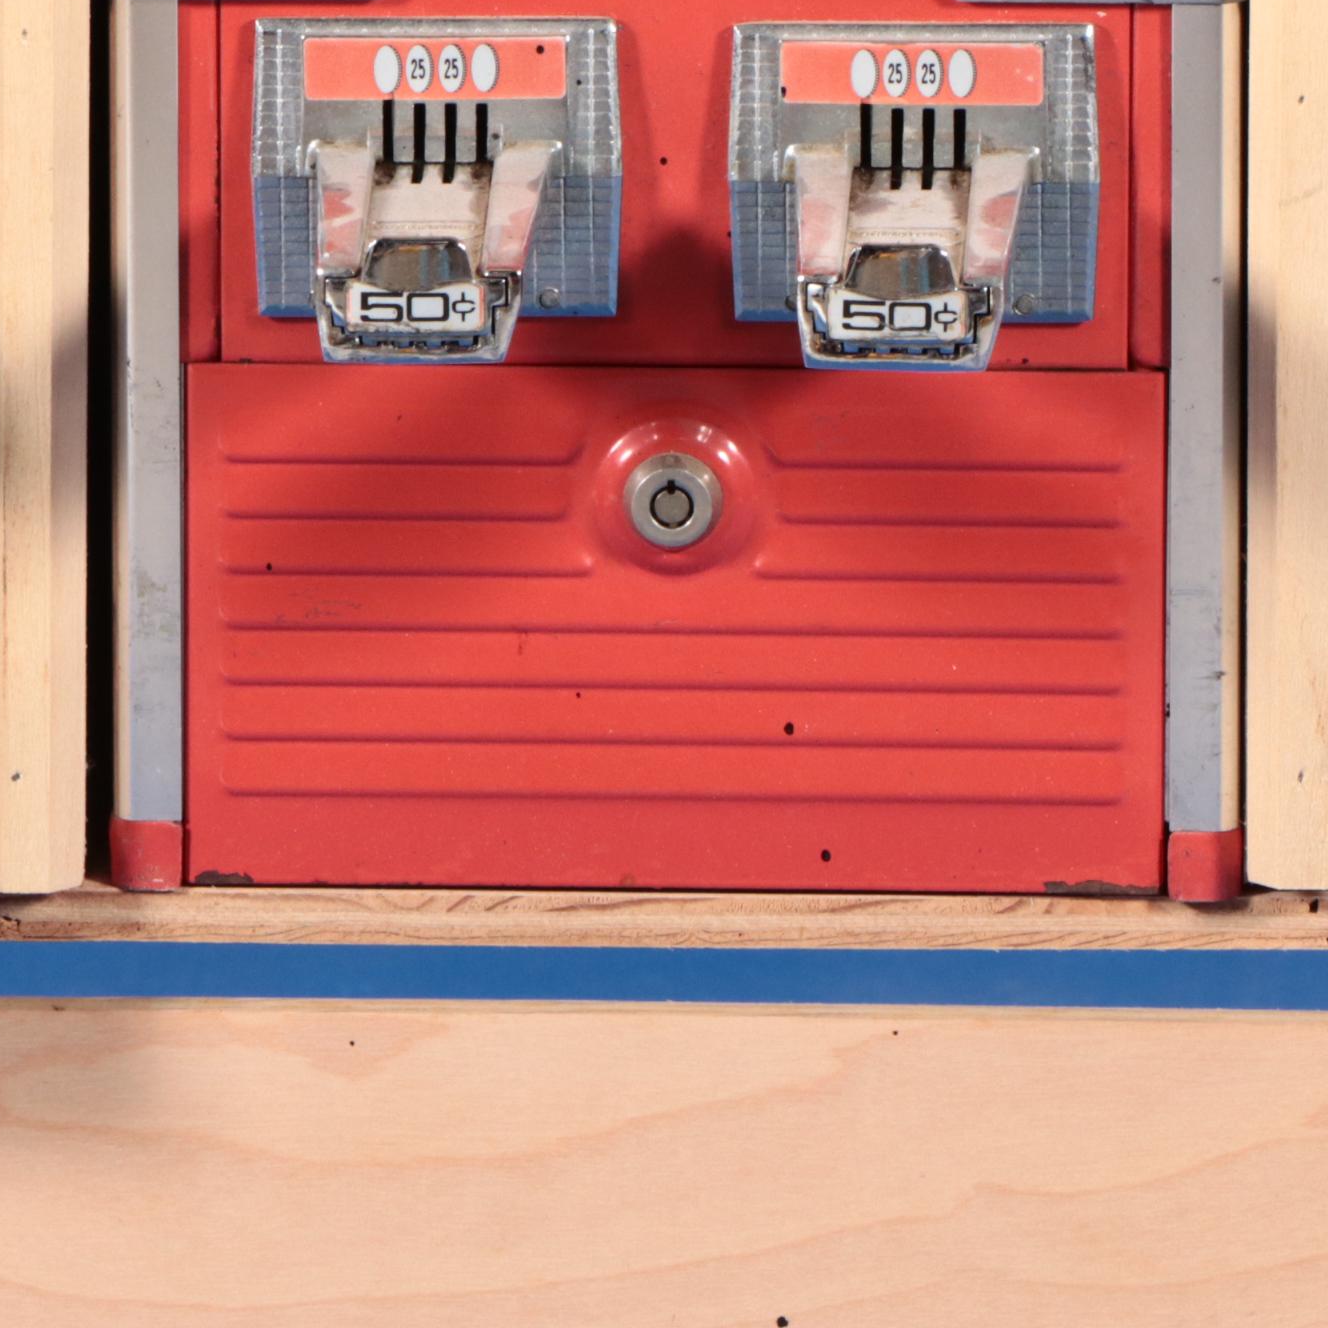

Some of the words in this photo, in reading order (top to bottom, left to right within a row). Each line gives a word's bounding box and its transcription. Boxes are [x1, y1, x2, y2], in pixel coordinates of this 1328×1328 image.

[410, 58, 427, 80] 25
[443, 58, 460, 80] 25
[887, 62, 904, 85] 25
[920, 62, 937, 85] 25
[359, 290, 476, 323] 50¢
[841, 299, 958, 332] 50¢
